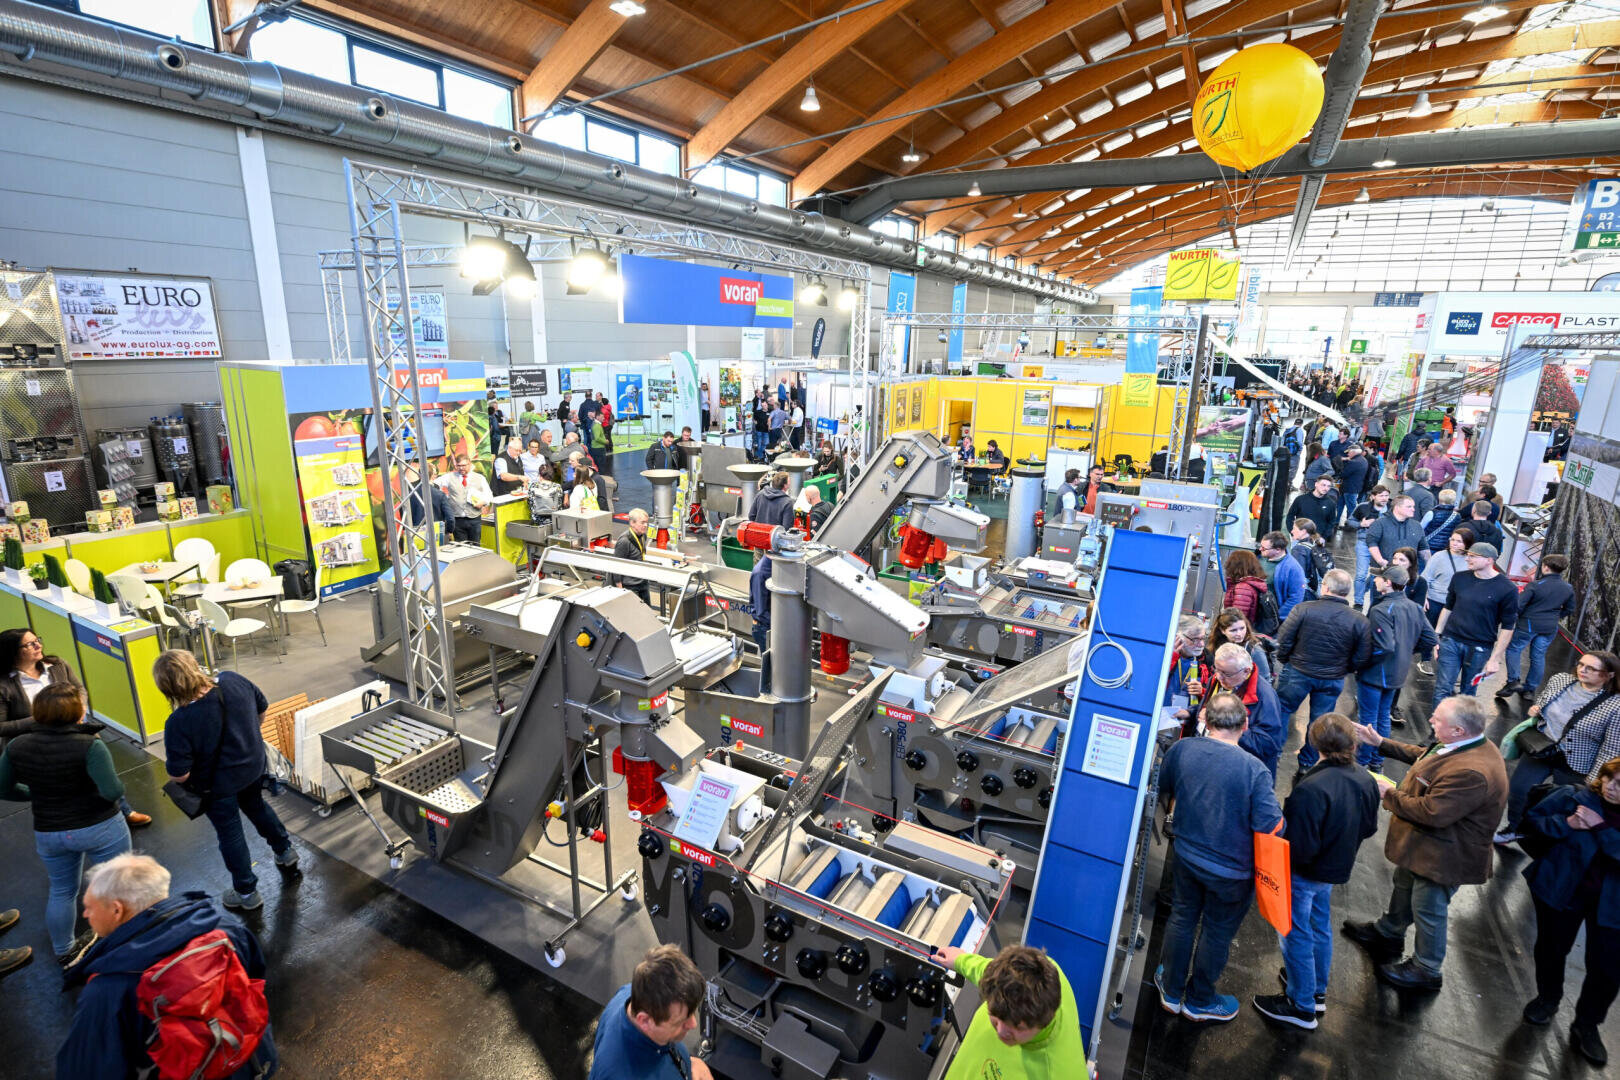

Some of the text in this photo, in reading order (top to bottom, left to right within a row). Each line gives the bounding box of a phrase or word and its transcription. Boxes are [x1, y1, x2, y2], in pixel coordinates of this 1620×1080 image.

[1591, 180, 1620, 209] B
[1598, 212, 1615, 221] B2
[1596, 221, 1613, 230] A1
[121, 285, 201, 308] EURO
[420, 294, 441, 305] EURO
[724, 283, 761, 303] voran
[1493, 314, 1619, 327] CARGO PLAST
[121, 328, 161, 336] Production
[101, 340, 216, 351] www.eurolux-ag.com
[400, 369, 444, 386] vran
[1013, 626, 1035, 637] voran
[887, 709, 913, 722] voran
[732, 720, 761, 735] voran
[1101, 723, 1130, 737] voran
[702, 782, 727, 799] voran
[427, 812, 448, 826] voran
[682, 846, 714, 866] voran
